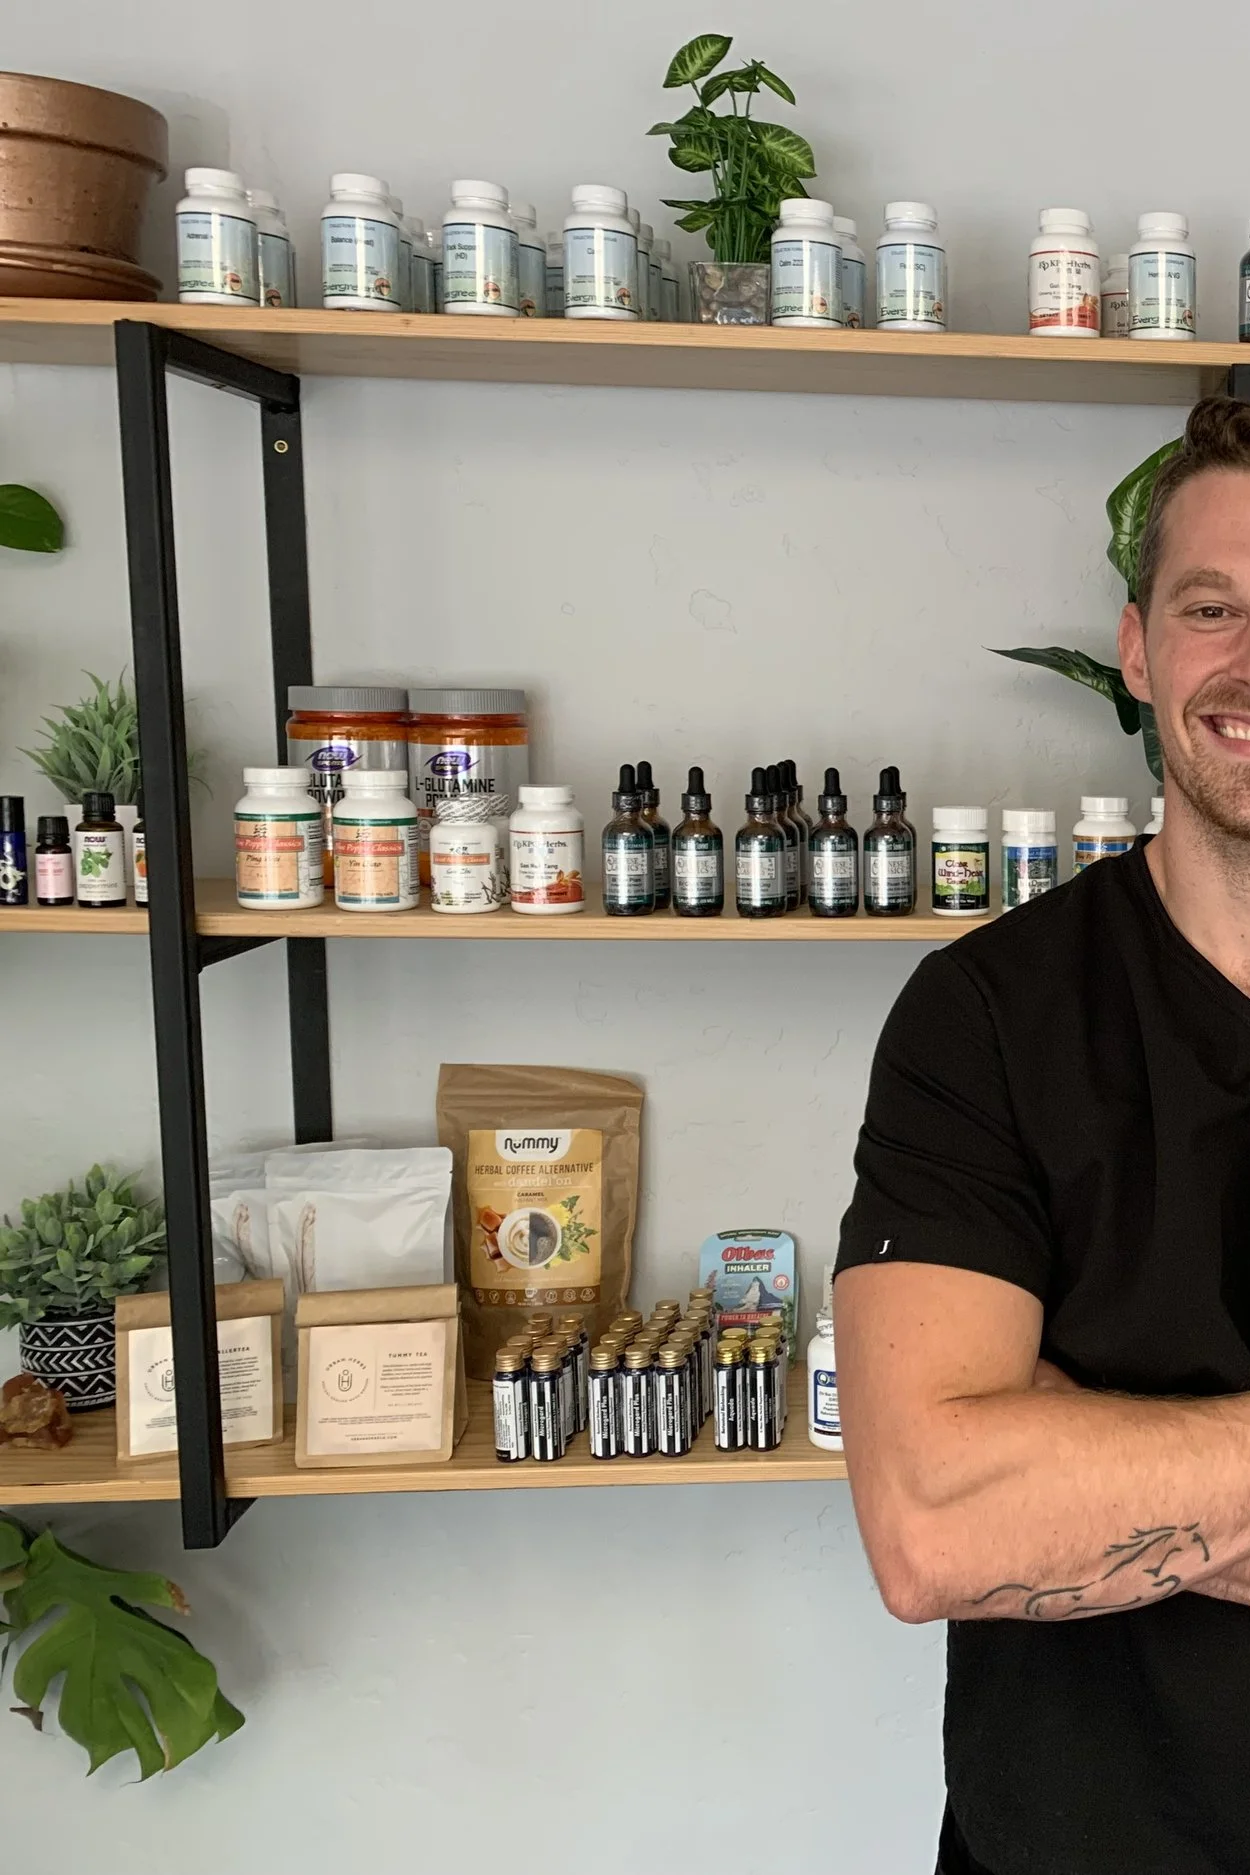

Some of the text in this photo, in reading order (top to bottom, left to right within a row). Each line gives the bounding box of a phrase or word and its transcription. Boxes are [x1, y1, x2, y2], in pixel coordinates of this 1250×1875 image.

[475, 1162, 594, 1175] HERBAL COFFEE ALTERNATIVE
[878, 1239, 891, 1255] J
[727, 1264, 769, 1273] INHALER
[601, 1407, 609, 1439] Microgard
[633, 1406, 641, 1437] Microgard
[666, 1405, 674, 1436] Microgard
